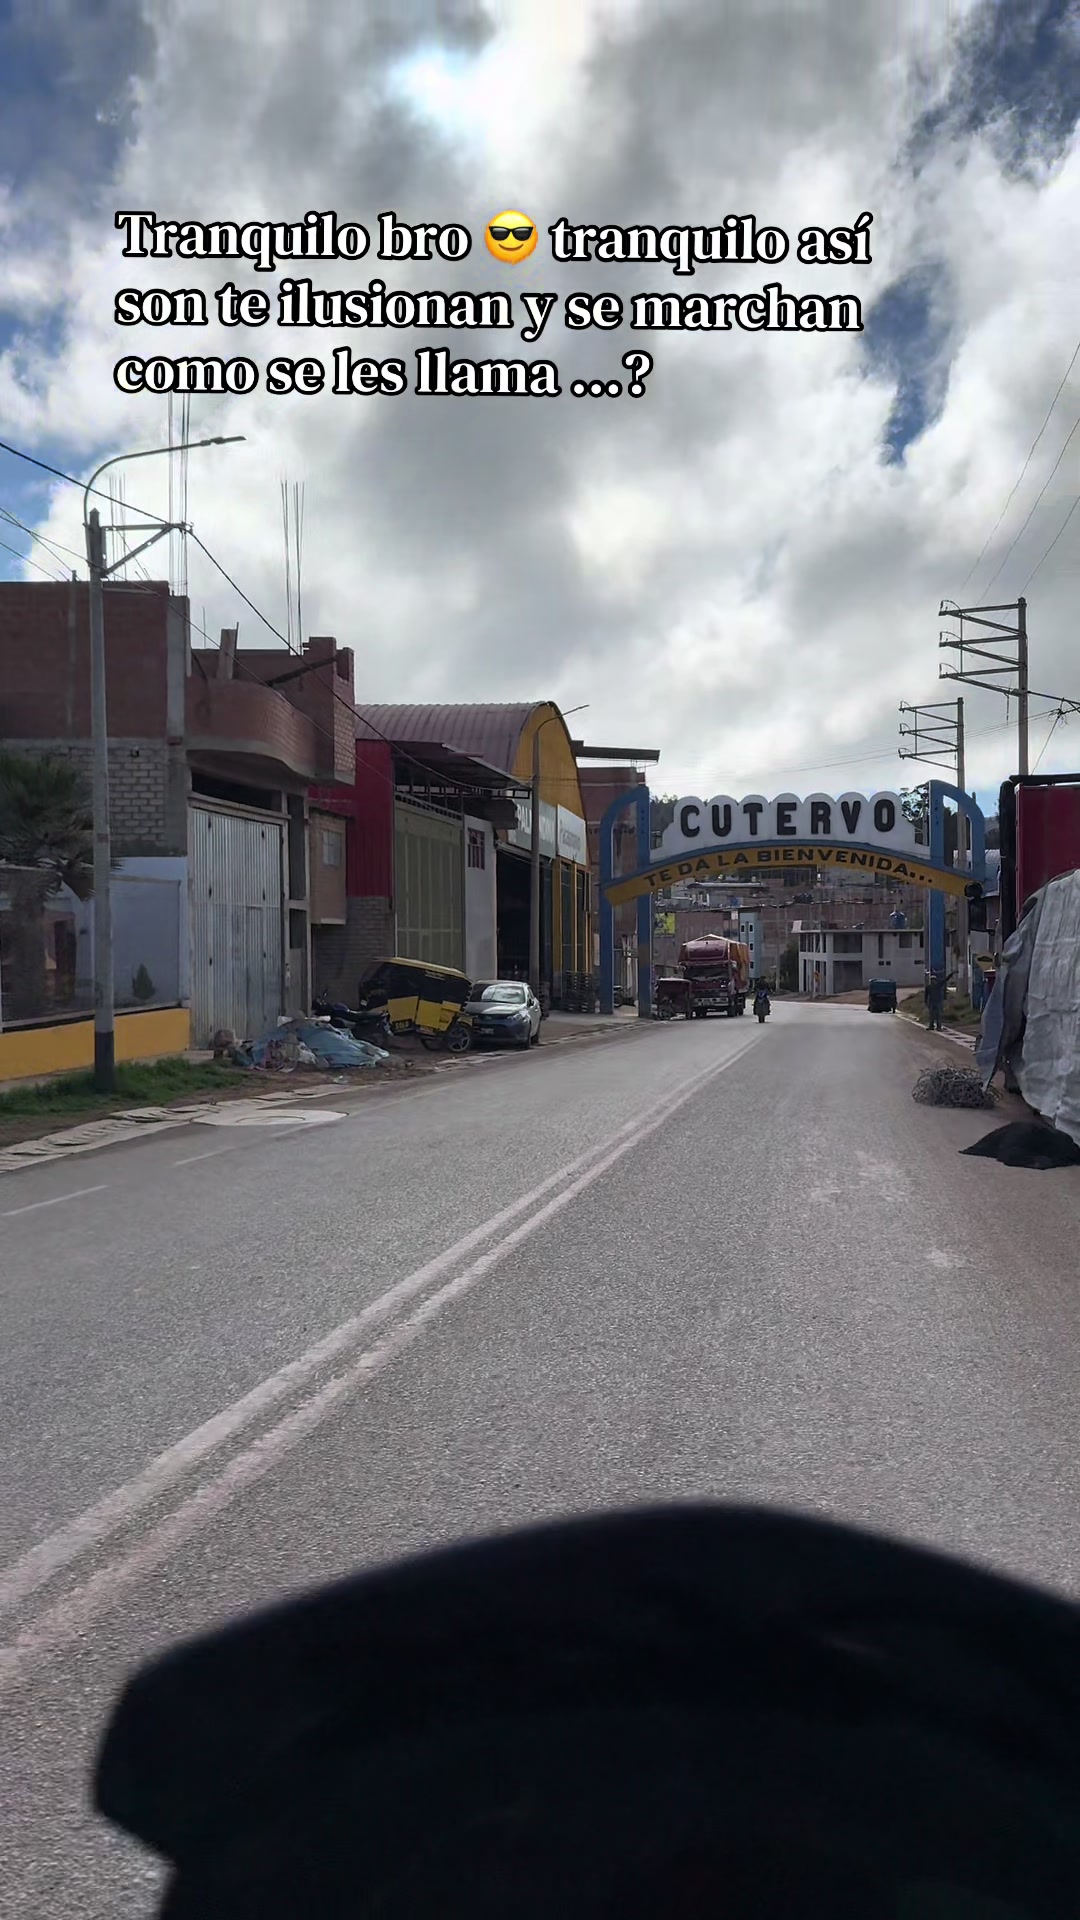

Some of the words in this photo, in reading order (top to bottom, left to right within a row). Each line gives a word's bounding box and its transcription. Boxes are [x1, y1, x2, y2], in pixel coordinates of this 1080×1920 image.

[680, 799, 895, 838] CUTERVO
[644, 869, 672, 887] TE
[678, 859, 710, 875] DA
[717, 852, 749, 867] LA
